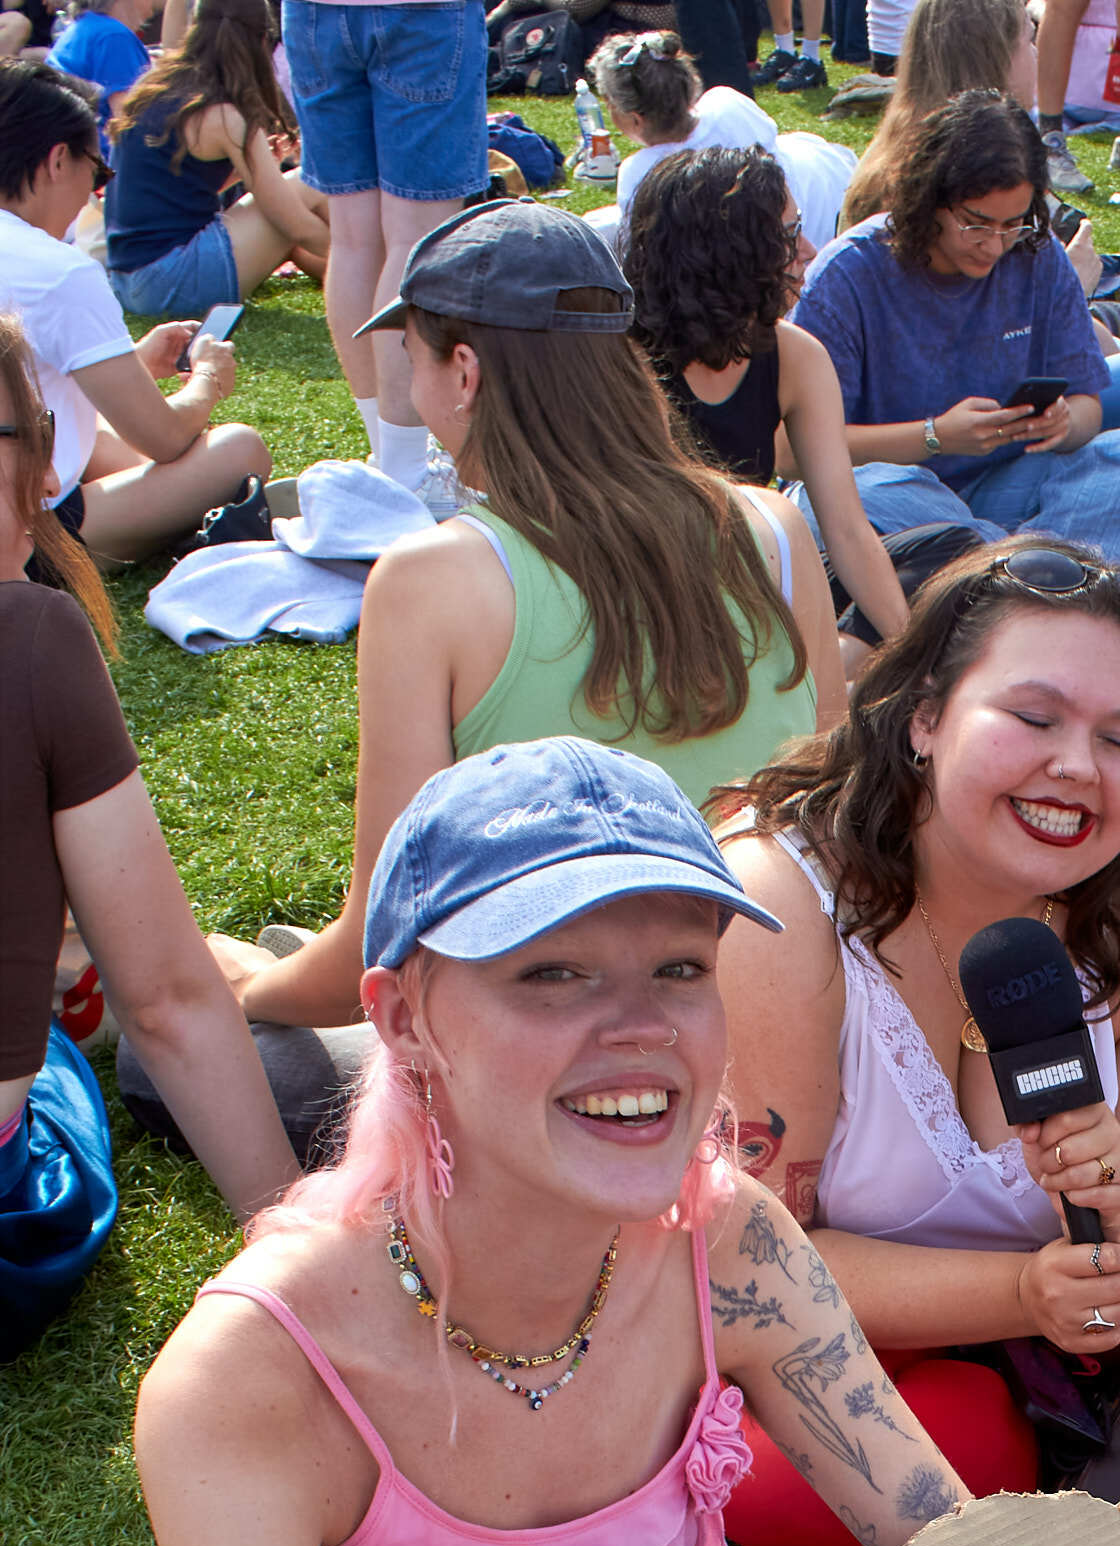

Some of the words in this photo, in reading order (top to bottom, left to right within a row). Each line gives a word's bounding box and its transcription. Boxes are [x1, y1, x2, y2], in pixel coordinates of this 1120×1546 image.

[484, 800, 558, 838] Made
[562, 797, 594, 816] In
[601, 792, 681, 822] Scotland
